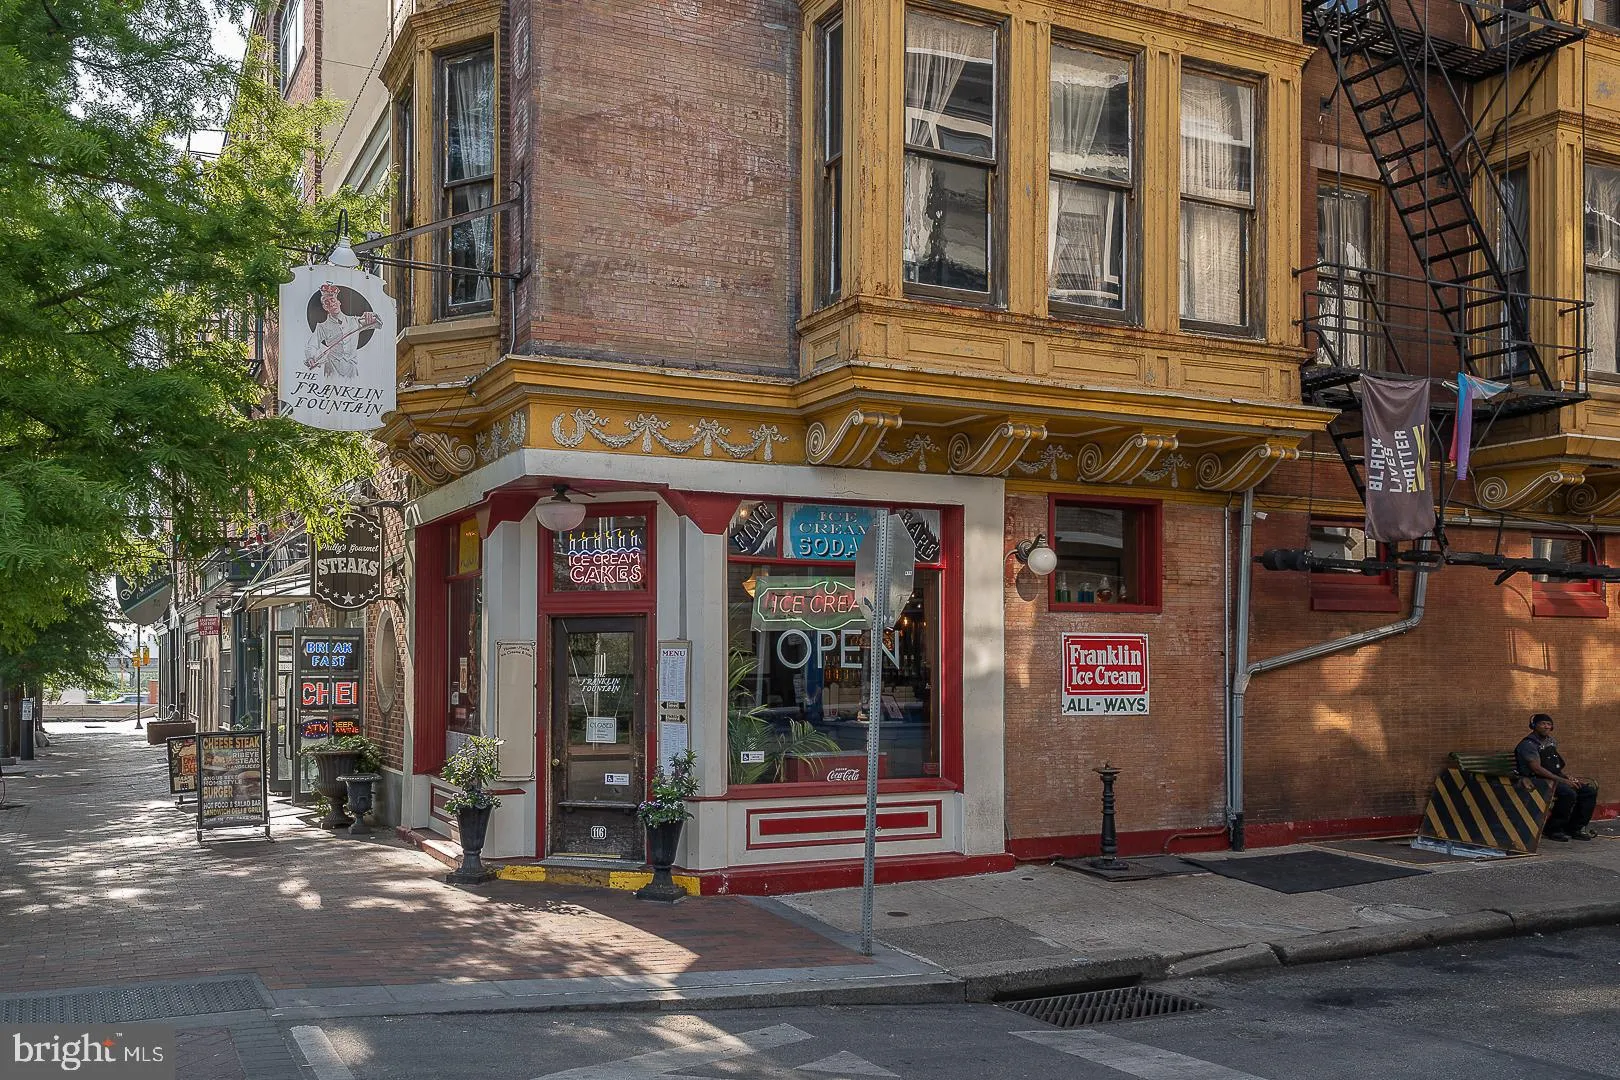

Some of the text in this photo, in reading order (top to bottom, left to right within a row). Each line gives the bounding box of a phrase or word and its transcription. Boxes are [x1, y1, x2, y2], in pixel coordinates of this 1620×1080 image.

[295, 371, 318, 381] THE
[291, 381, 384, 403] FRANKLIN
[294, 396, 384, 417] FOUNTAIN
[1368, 437, 1386, 491] BLACK
[1383, 446, 1402, 492] LIVES
[1394, 430, 1417, 493] MATTER
[820, 512, 857, 523] ICE
[734, 503, 776, 553] FINE
[319, 542, 379, 554] Philly's Gourmet
[799, 536, 859, 557] SODA
[317, 557, 380, 577] STEAKS
[568, 552, 641, 567] ICE CREAM
[570, 565, 642, 584] CAKES
[772, 594, 860, 614] ICE CREA
[777, 628, 900, 670] OPEN
[1069, 644, 1142, 666] Franklin
[311, 656, 346, 667] FAST
[580, 677, 621, 686] FRANKLIN
[1071, 666, 1142, 685] Ice Cream
[581, 685, 621, 693] FOUNTAIN
[305, 724, 329, 735] ATM
[203, 736, 260, 750] CHEESE STEAK
[203, 785, 233, 799] BURGER
[203, 809, 231, 817] SANDWICH
[247, 806, 262, 814] GRILL
[214, 801, 228, 809] FOOD
[251, 799, 262, 807] BAR
[593, 828, 604, 839] 116
